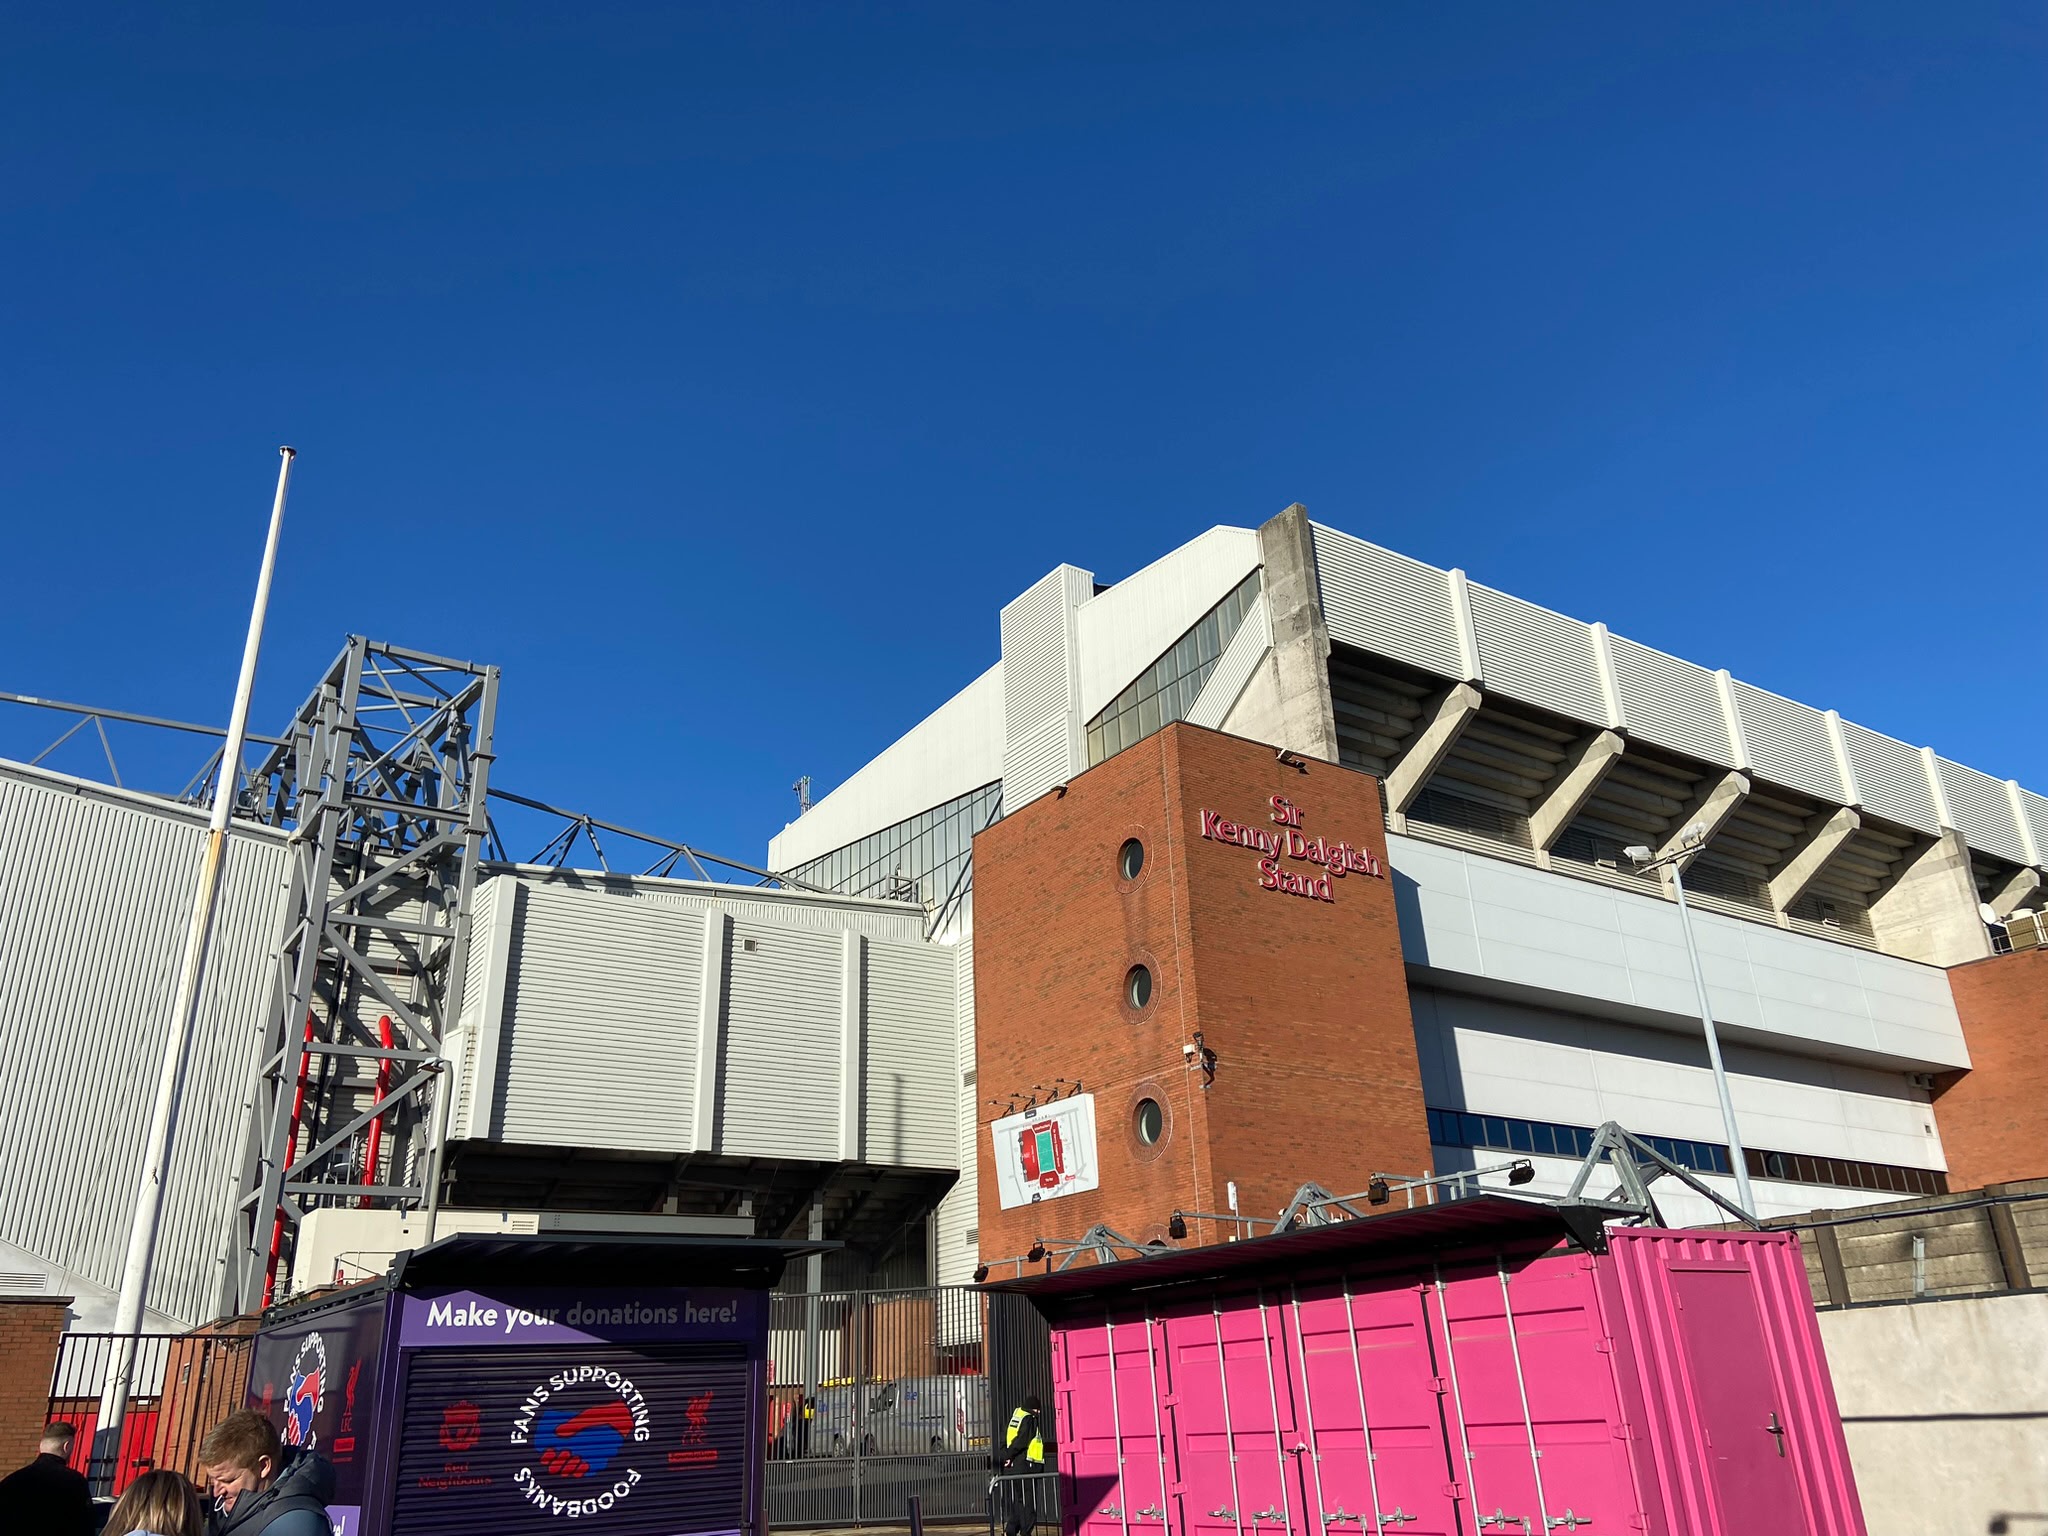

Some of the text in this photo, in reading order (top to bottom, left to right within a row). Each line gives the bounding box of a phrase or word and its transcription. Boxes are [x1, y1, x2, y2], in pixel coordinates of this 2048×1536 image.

[1270, 794, 1304, 828] Sir
[1200, 808, 1384, 878] Kenny Dalglish
[1258, 858, 1335, 902] Stand
[426, 1300, 738, 1334] Make your donations here!
[510, 1366, 650, 1444] FANS SUPPORTING
[514, 1467, 642, 1518] FOODBANKS
